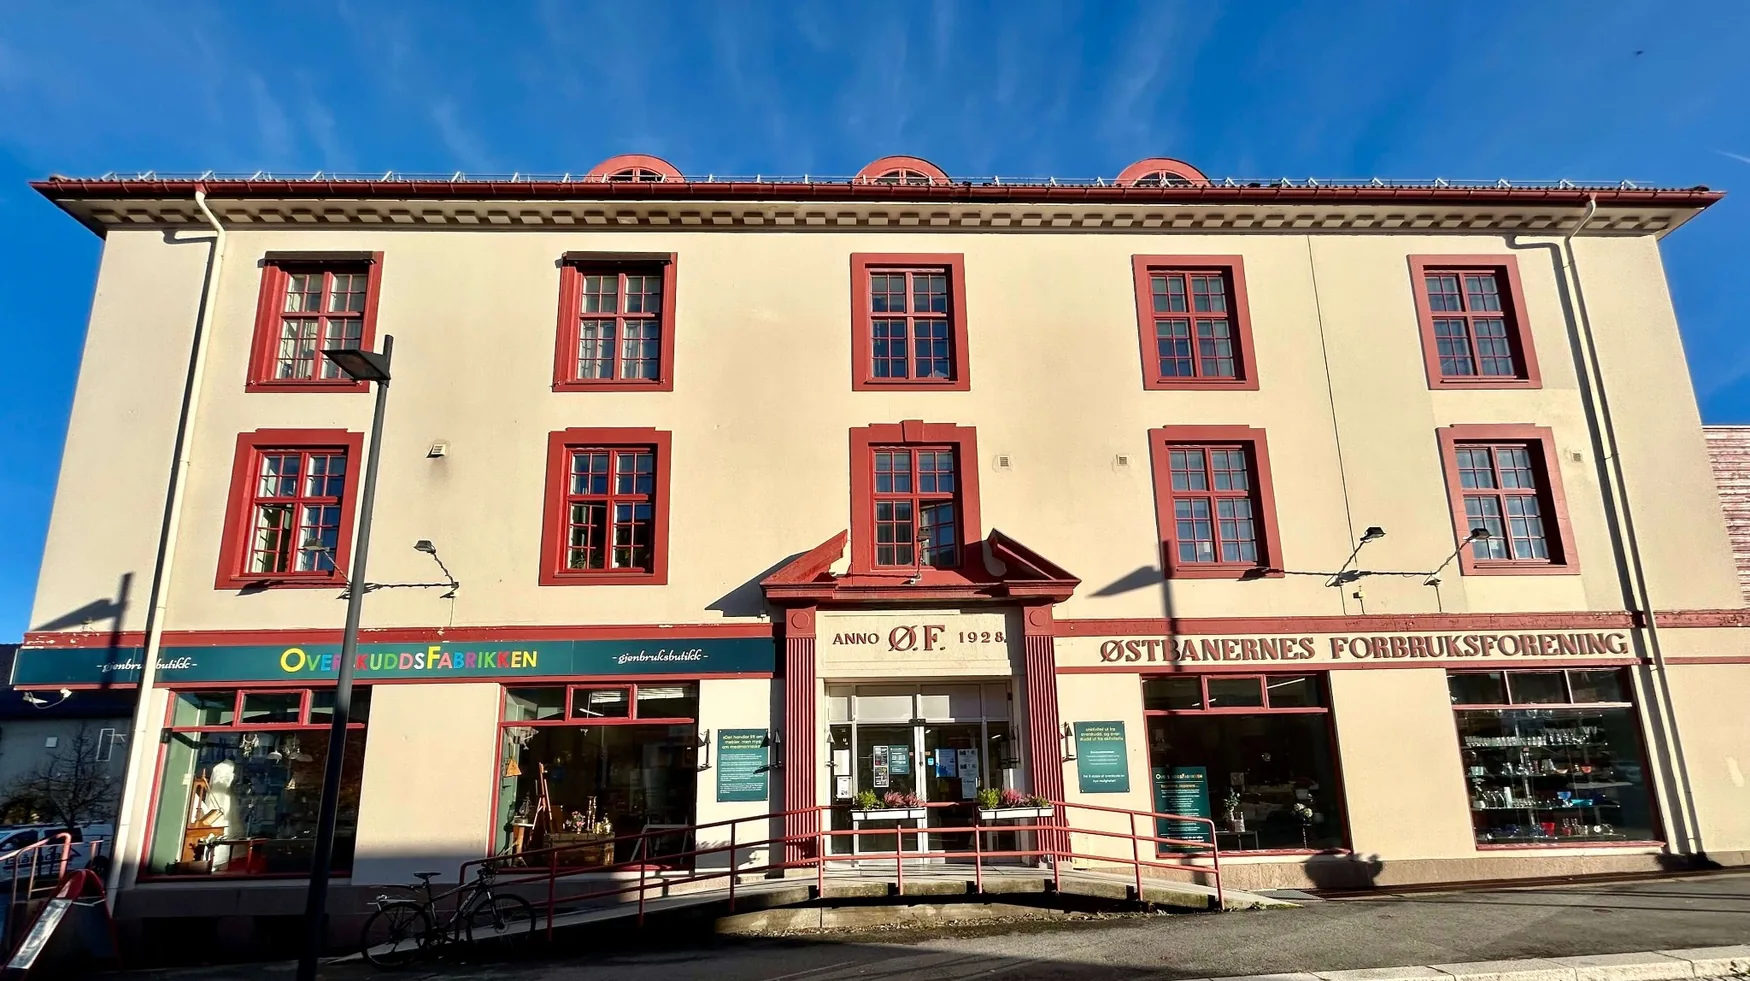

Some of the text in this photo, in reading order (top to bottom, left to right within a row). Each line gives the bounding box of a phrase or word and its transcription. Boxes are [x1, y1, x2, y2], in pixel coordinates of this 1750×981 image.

[832, 632, 880, 645] ANNO
[1100, 632, 1629, 663] ØSTBANERNES FORBRUKSFORENING
[280, 645, 538, 673] OVERKUDDSFABRIKKEN
